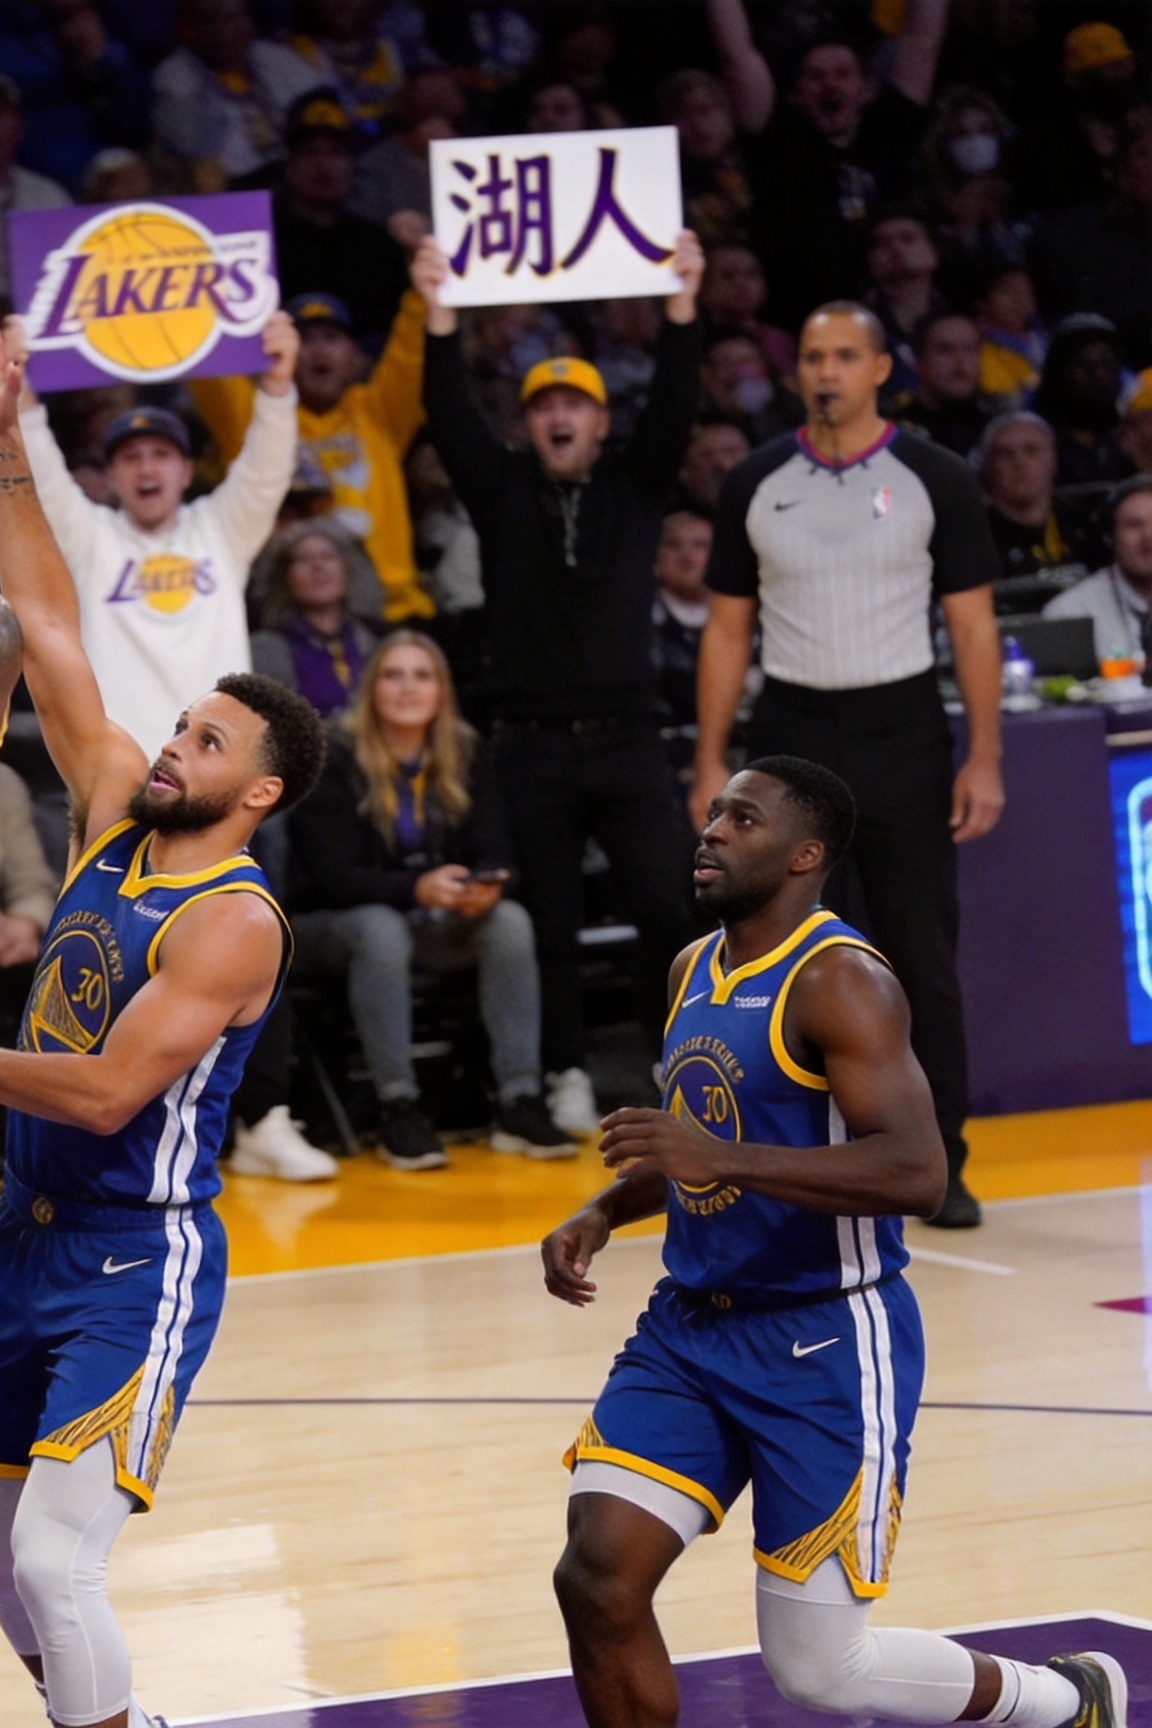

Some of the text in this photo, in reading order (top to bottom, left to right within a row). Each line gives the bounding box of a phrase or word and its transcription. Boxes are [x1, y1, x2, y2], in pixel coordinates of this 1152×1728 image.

[448, 147, 676, 278] 湖人
[32, 253, 257, 338] LAKERS
[71, 967, 104, 1010] 30
